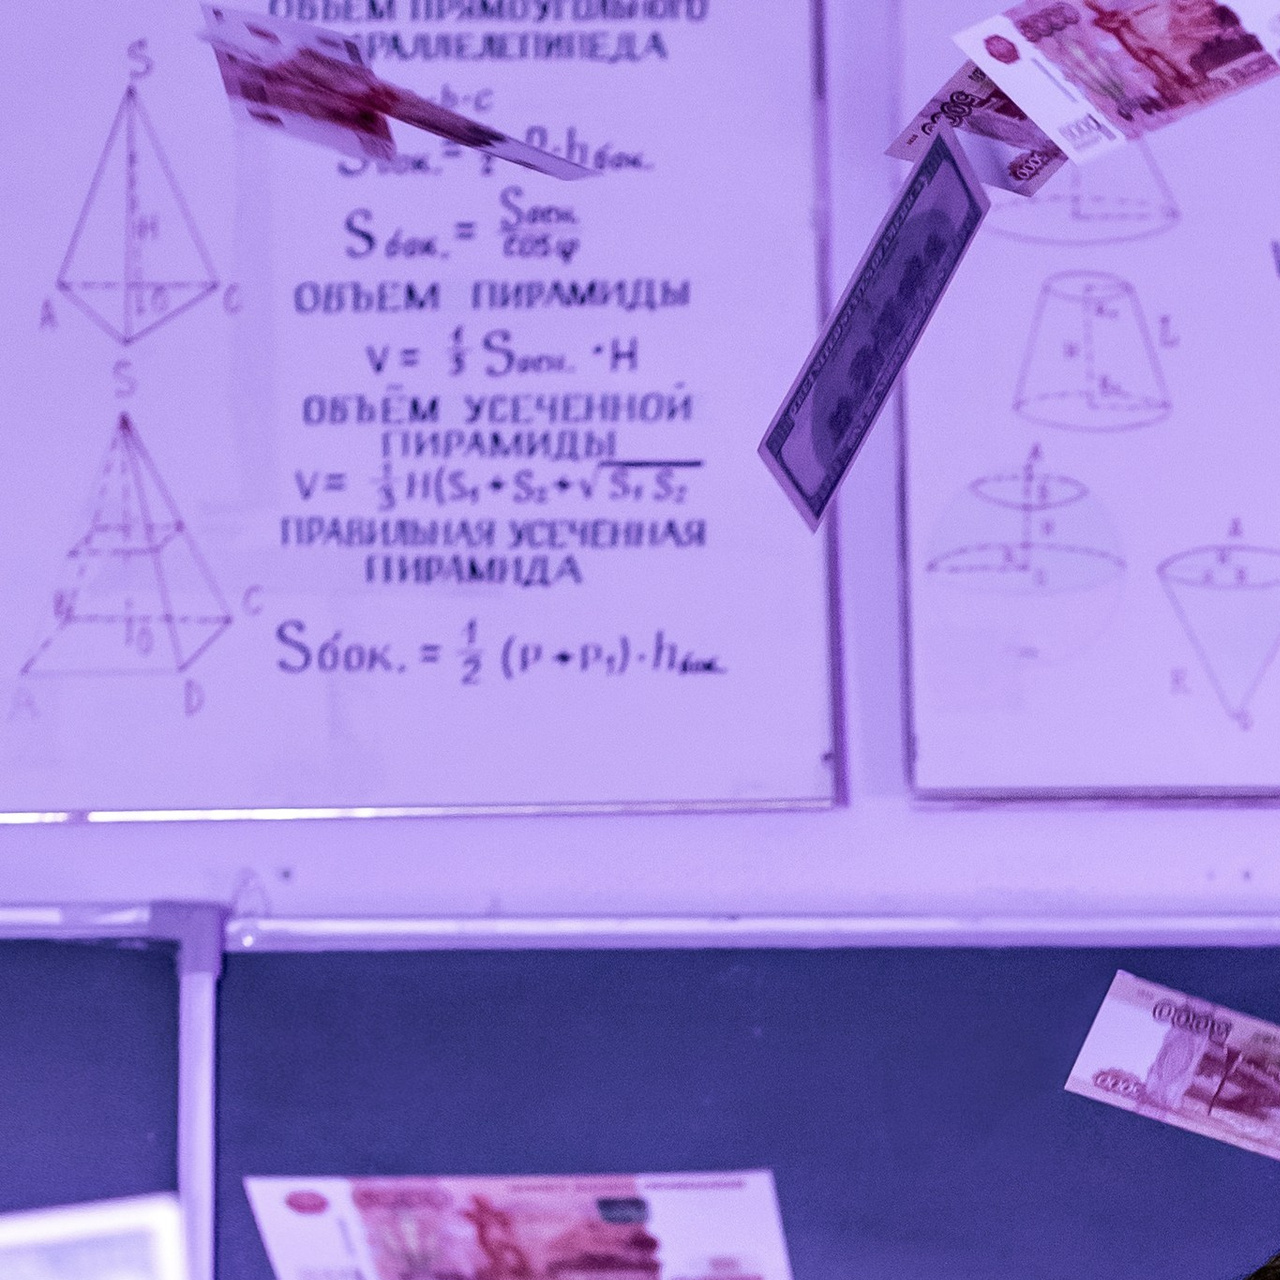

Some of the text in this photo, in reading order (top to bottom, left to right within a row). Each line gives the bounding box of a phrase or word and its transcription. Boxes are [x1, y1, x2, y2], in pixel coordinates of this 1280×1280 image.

[352, 29, 669, 63] РАЛЛЕЛЕПИПЕДА
[470, 278, 692, 312] ПИРАМИДЫ
[463, 381, 693, 425] УСЕЧЕННОЙ
[381, 428, 617, 461] ПИРАМИДЫ
[280, 515, 706, 548] ПРАВИЛЬНАЯ УСЕЧЕННАЯ
[363, 553, 583, 587] ПИРАМИДА
